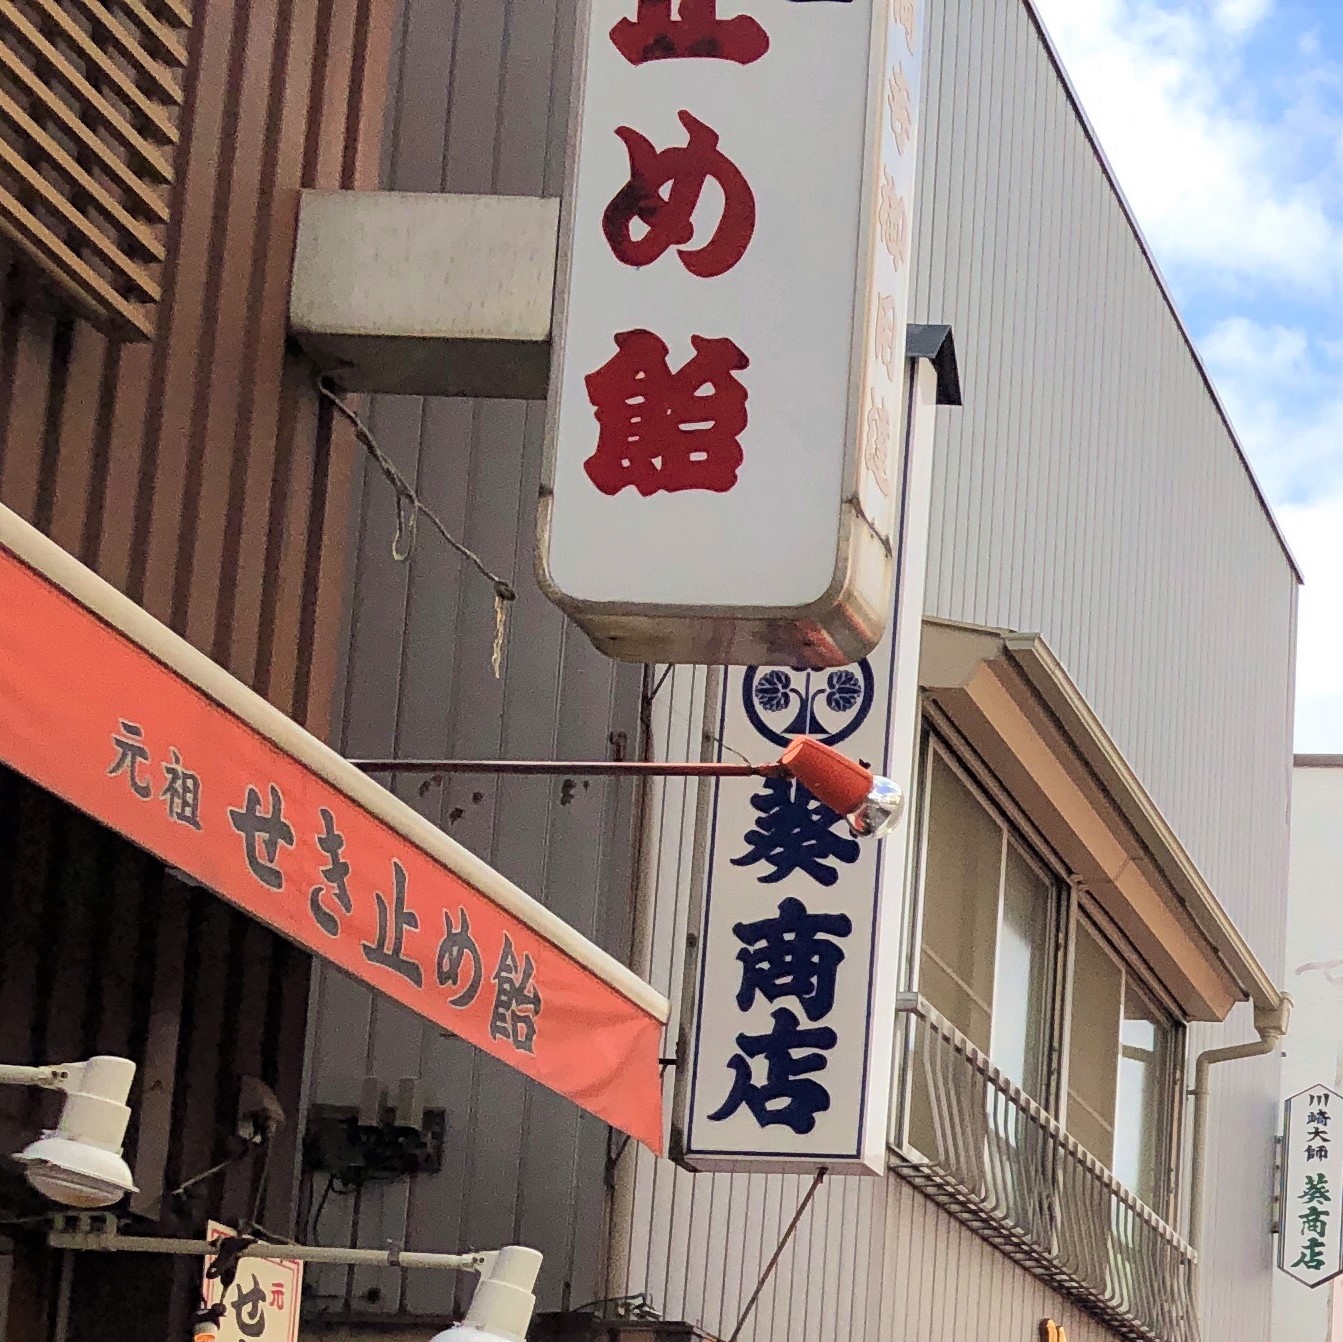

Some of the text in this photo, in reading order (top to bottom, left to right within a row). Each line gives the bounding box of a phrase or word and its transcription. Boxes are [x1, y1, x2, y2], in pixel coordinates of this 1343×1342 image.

[105, 718, 543, 1054] 元祖 せき止め飴
[708, 776, 860, 1136] 葵商店
[1291, 1174, 1331, 1271] 葵商店
